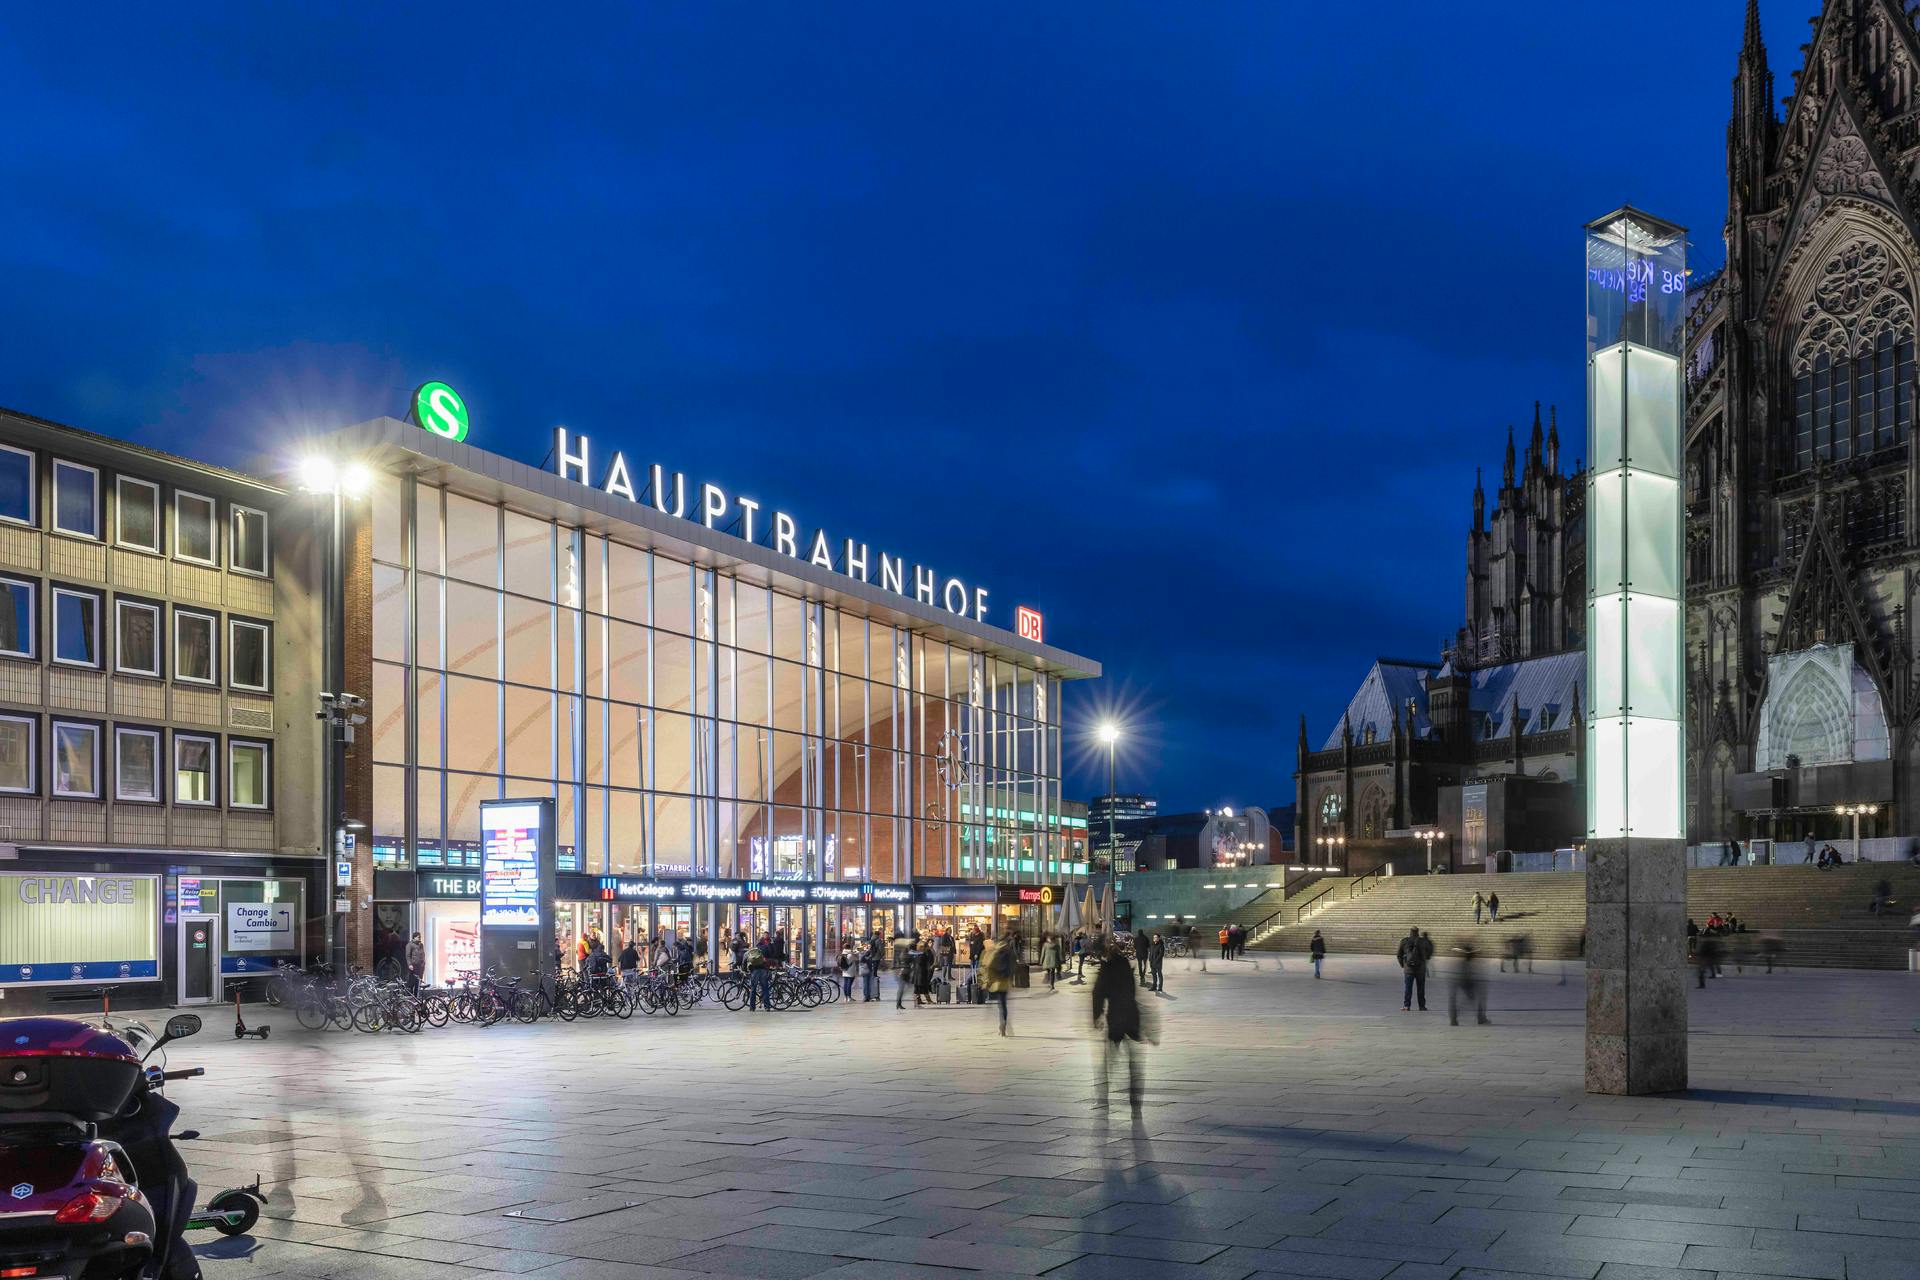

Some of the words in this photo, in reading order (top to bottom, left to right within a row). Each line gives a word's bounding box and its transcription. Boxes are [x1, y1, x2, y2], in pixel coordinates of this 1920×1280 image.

[428, 389, 460, 439] S
[554, 427, 989, 622] HAUPTBAHNHOF
[1021, 611, 1039, 641] DB
[19, 878, 135, 904] CHANGE
[433, 879, 463, 894] THE
[619, 883, 675, 898] NetCologne
[698, 884, 742, 899] Highspeed
[762, 886, 805, 900] NetCologne
[823, 886, 859, 900] Highspeed
[874, 888, 910, 901] NetCologne
[236, 907, 269, 918] Change
[246, 918, 278, 927] Cambio
